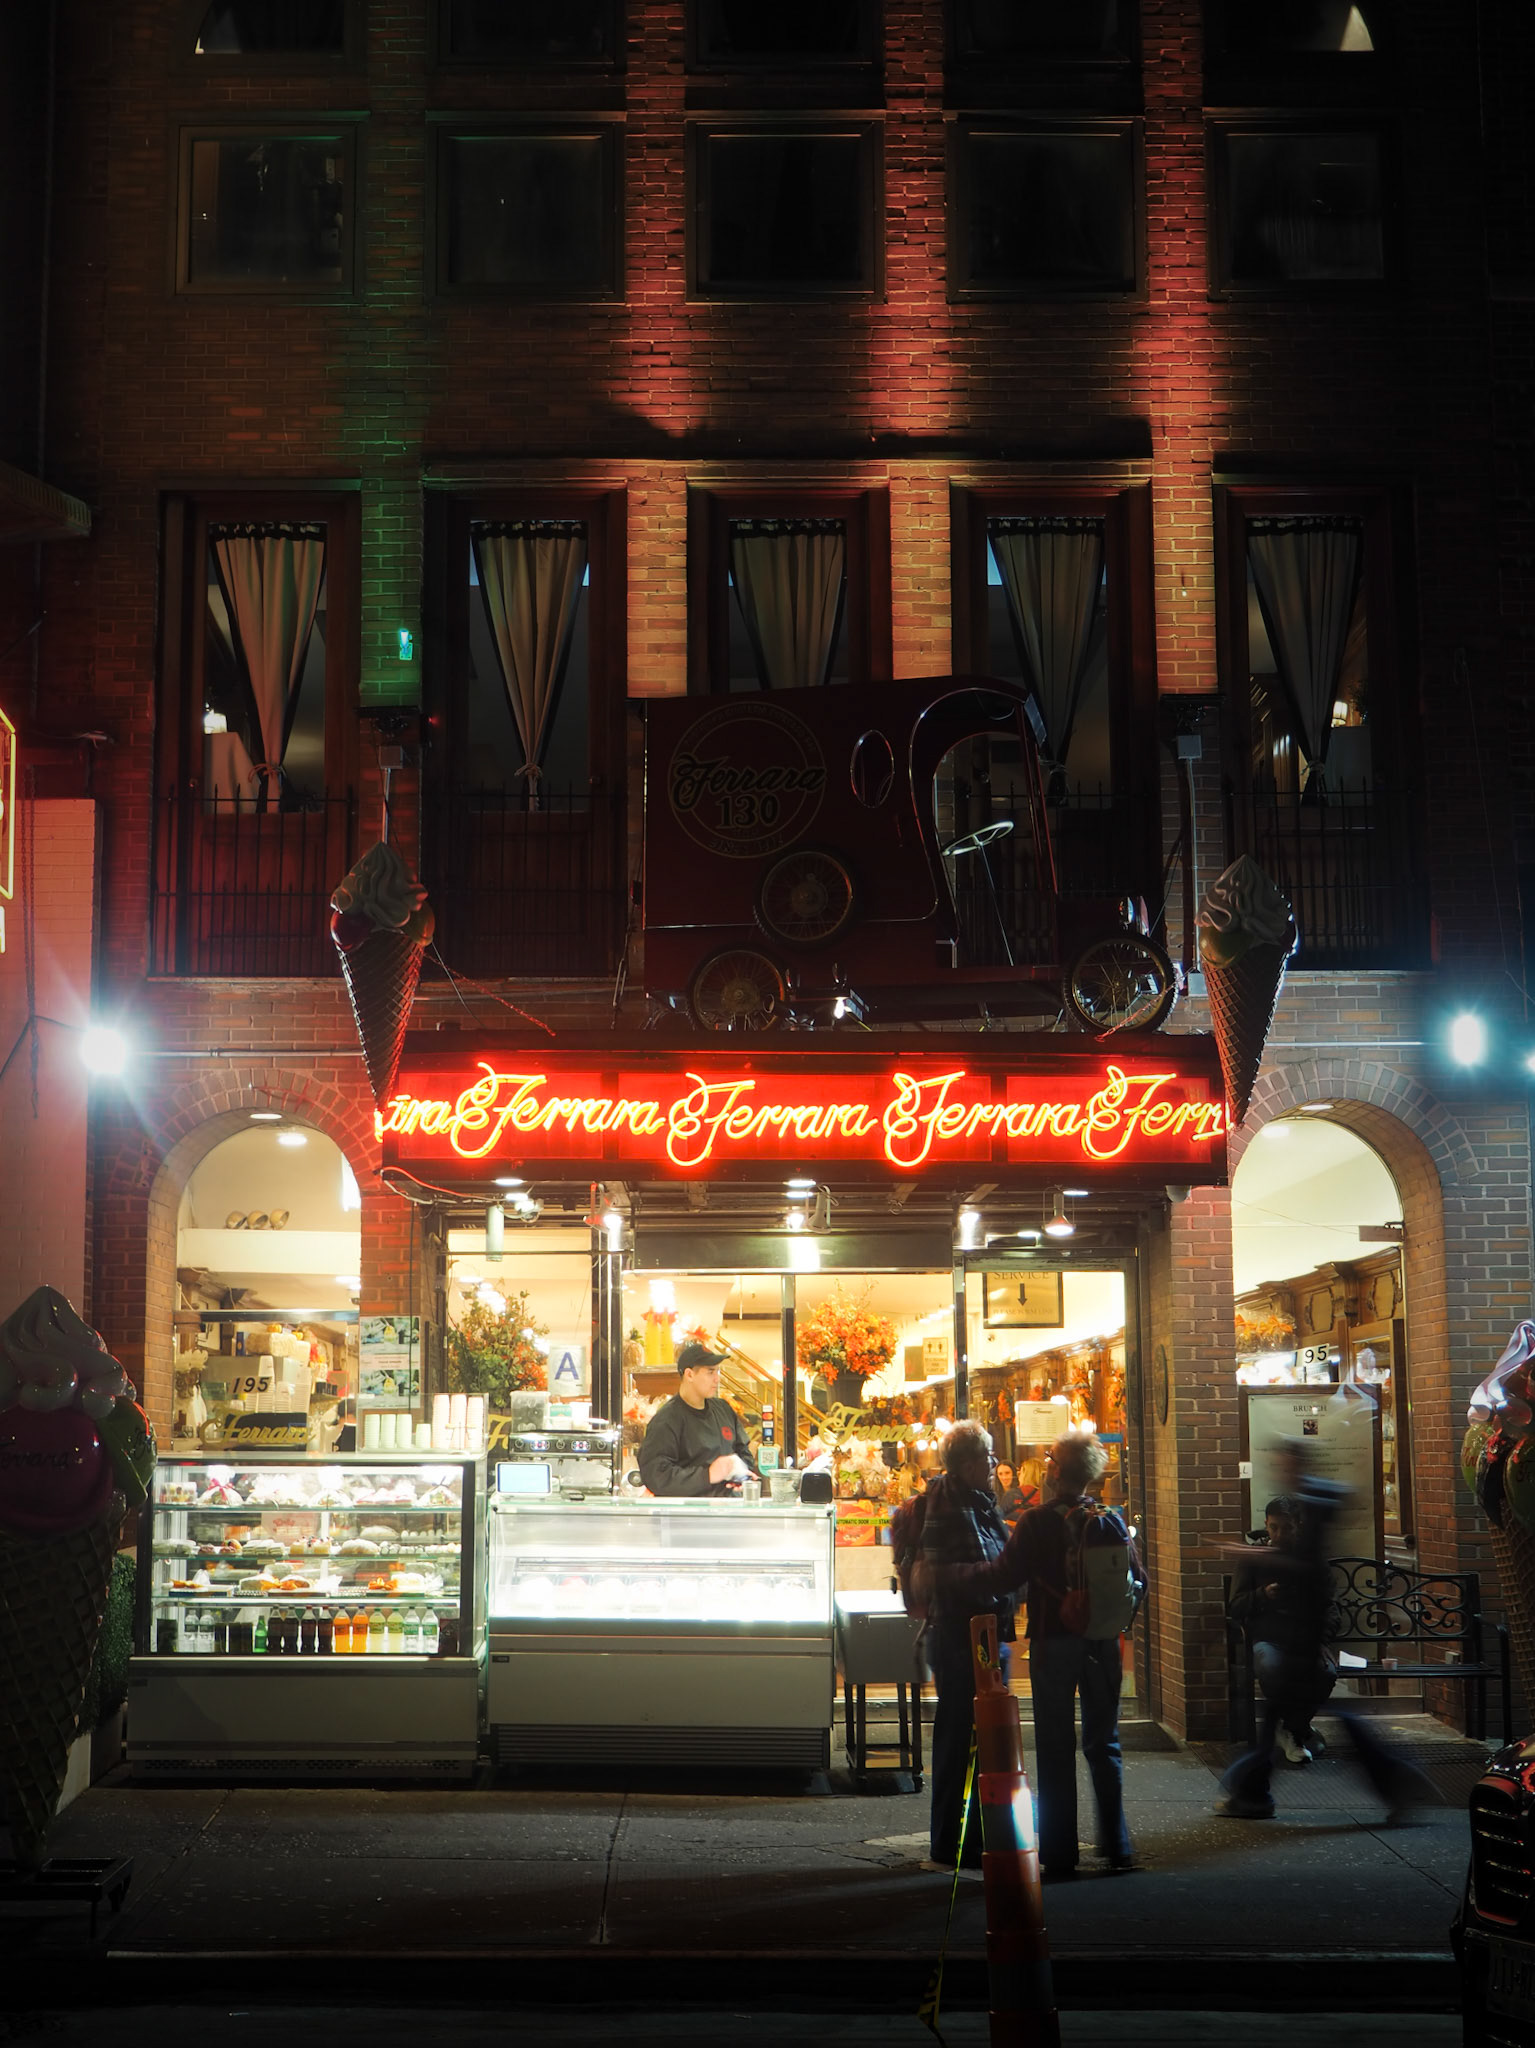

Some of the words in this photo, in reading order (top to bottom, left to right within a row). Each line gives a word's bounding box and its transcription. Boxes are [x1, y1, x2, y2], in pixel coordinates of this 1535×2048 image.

[671, 752, 828, 811] Ferrara
[715, 792, 781, 829] 130
[450, 1062, 666, 1159] Ferrara
[665, 1072, 878, 1167] Ferrara
[883, 1072, 1087, 1168] Ferrara
[993, 1271, 1050, 1280] SERVICE
[554, 1351, 580, 1380] A
[1294, 1345, 1328, 1367] 195
[233, 1376, 269, 1393] 195
[200, 1403, 317, 1449] Ferrara
[818, 1401, 936, 1446] Ferrara
